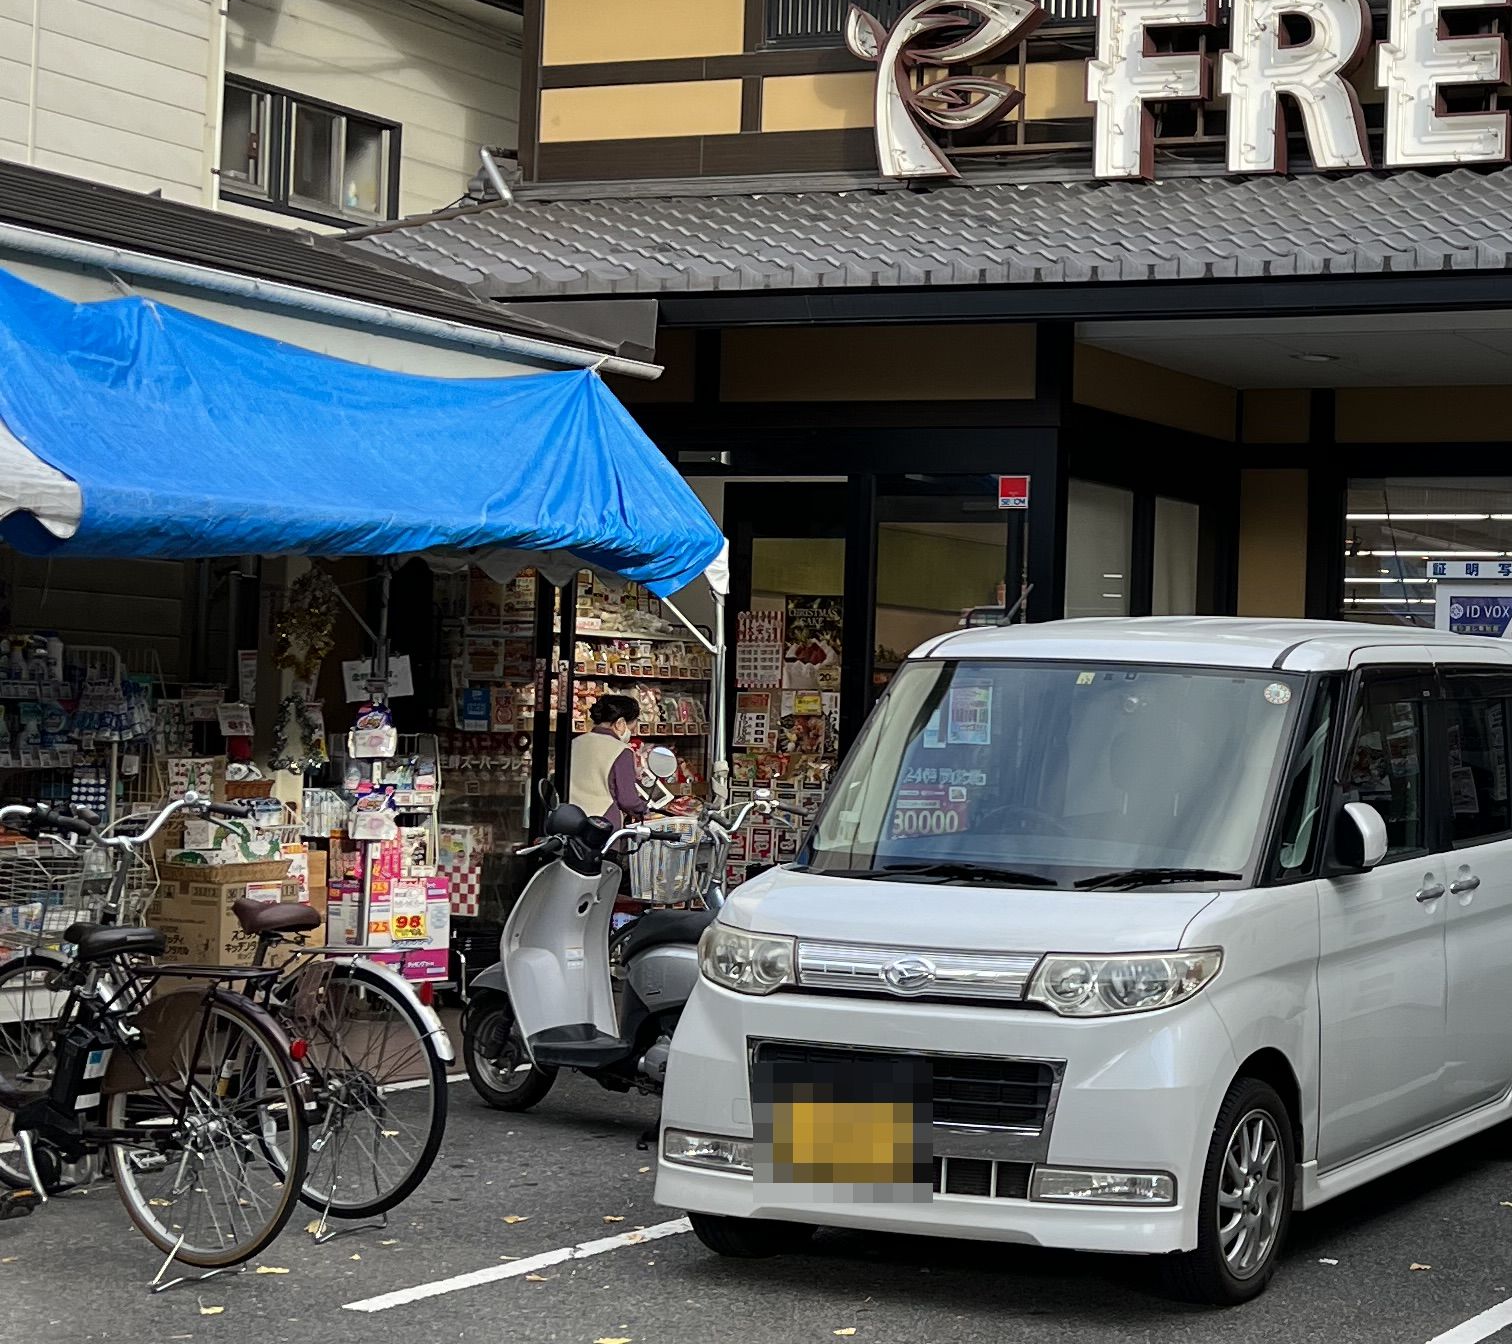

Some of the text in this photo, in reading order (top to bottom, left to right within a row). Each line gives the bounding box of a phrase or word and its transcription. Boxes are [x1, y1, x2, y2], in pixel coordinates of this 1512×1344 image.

[788, 608, 838, 617] CHRISTMAS
[1466, 605, 1511, 619] ID VOX
[800, 617, 825, 626] CAKE
[395, 915, 421, 928] 98
